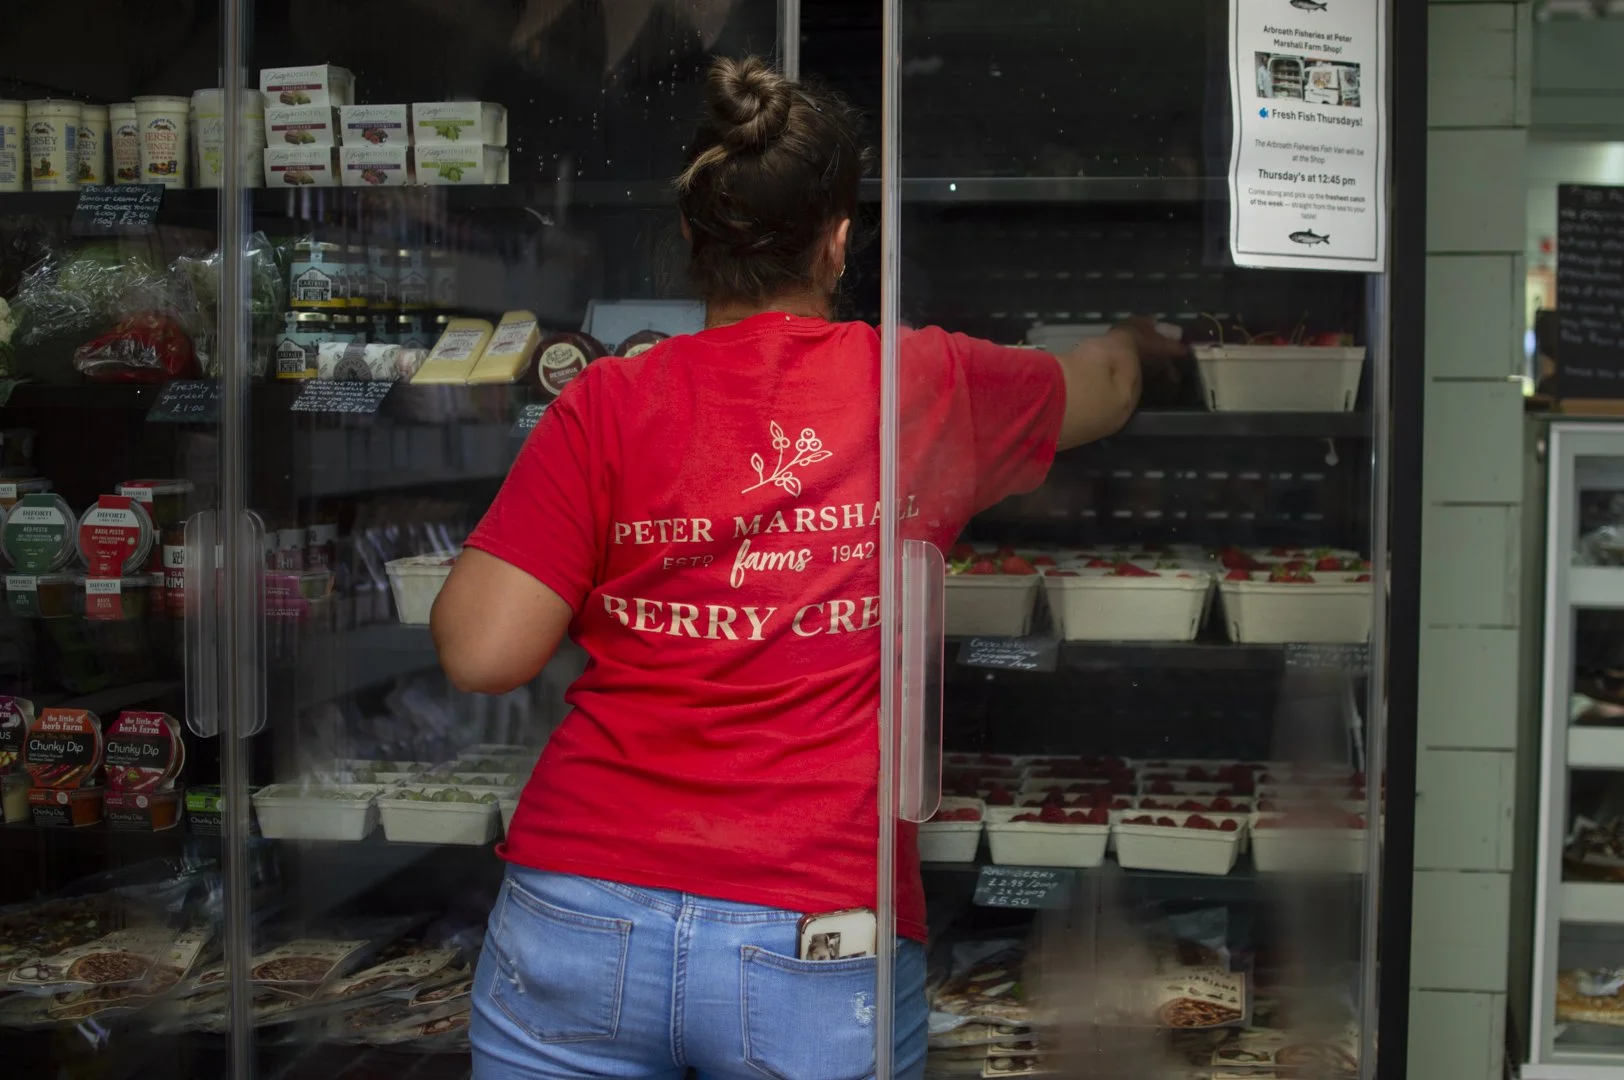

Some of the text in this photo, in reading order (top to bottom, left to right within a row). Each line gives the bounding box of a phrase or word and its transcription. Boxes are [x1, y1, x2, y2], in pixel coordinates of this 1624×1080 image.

[1263, 25, 1352, 44] Arbroath Fisheries at Peter
[1273, 38, 1343, 54] Marshall Farm Shop!
[1272, 109, 1363, 128] Fresh Fish Thursdays!
[144, 132, 178, 141] JERSEY
[1310, 156, 1325, 165] Shop
[1258, 168, 1356, 187] Thursday's at 12:45 pm
[549, 367, 578, 379] RESERVA
[614, 517, 714, 545] PETER
[730, 539, 812, 589] farms
[831, 541, 876, 564] 1942
[601, 593, 882, 641] BERRY CRE
[47, 714, 74, 723] the little
[125, 716, 151, 725] the little
[41, 722, 83, 732] herb farm
[119, 723, 159, 734] herb farm
[29, 739, 84, 755] Chunky Dip
[107, 742, 160, 757] Chunky Dip
[32, 807, 65, 816] Chunky Dip
